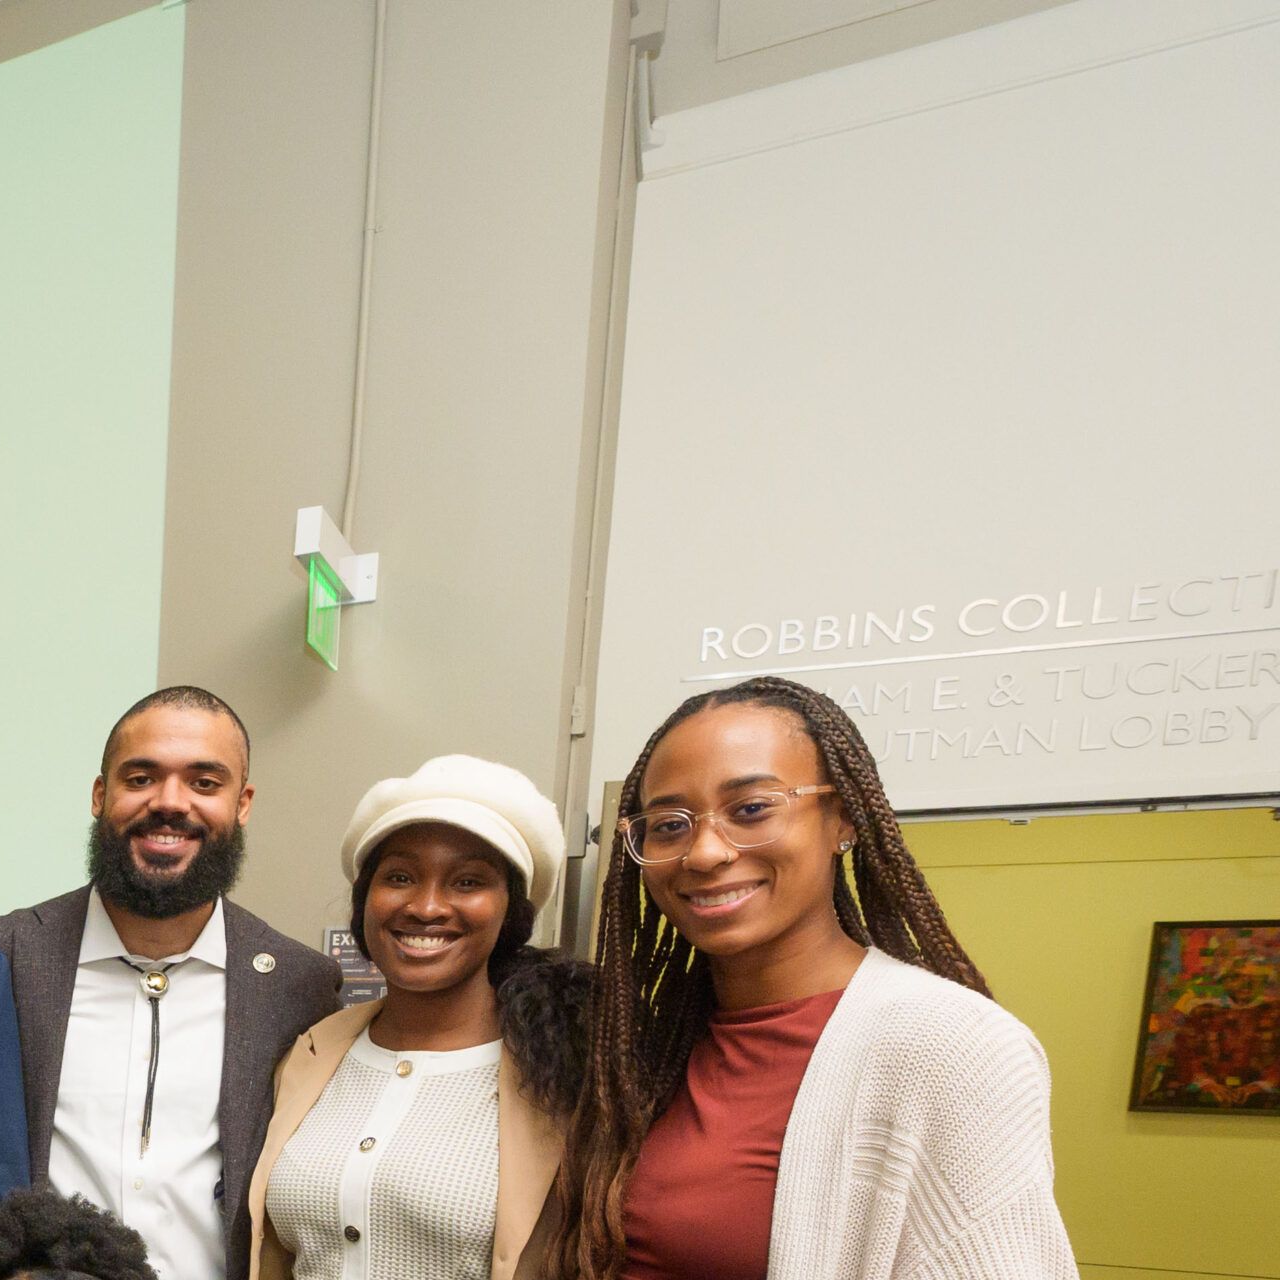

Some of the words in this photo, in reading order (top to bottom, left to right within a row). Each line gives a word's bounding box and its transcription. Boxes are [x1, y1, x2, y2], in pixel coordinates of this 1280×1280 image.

[699, 603, 937, 663] ROBBINS
[824, 680, 913, 717] AM
[932, 675, 967, 712] E.
[987, 672, 1025, 708] &
[1042, 650, 1280, 702] TUCKER
[1078, 702, 1280, 752] LOBBY
